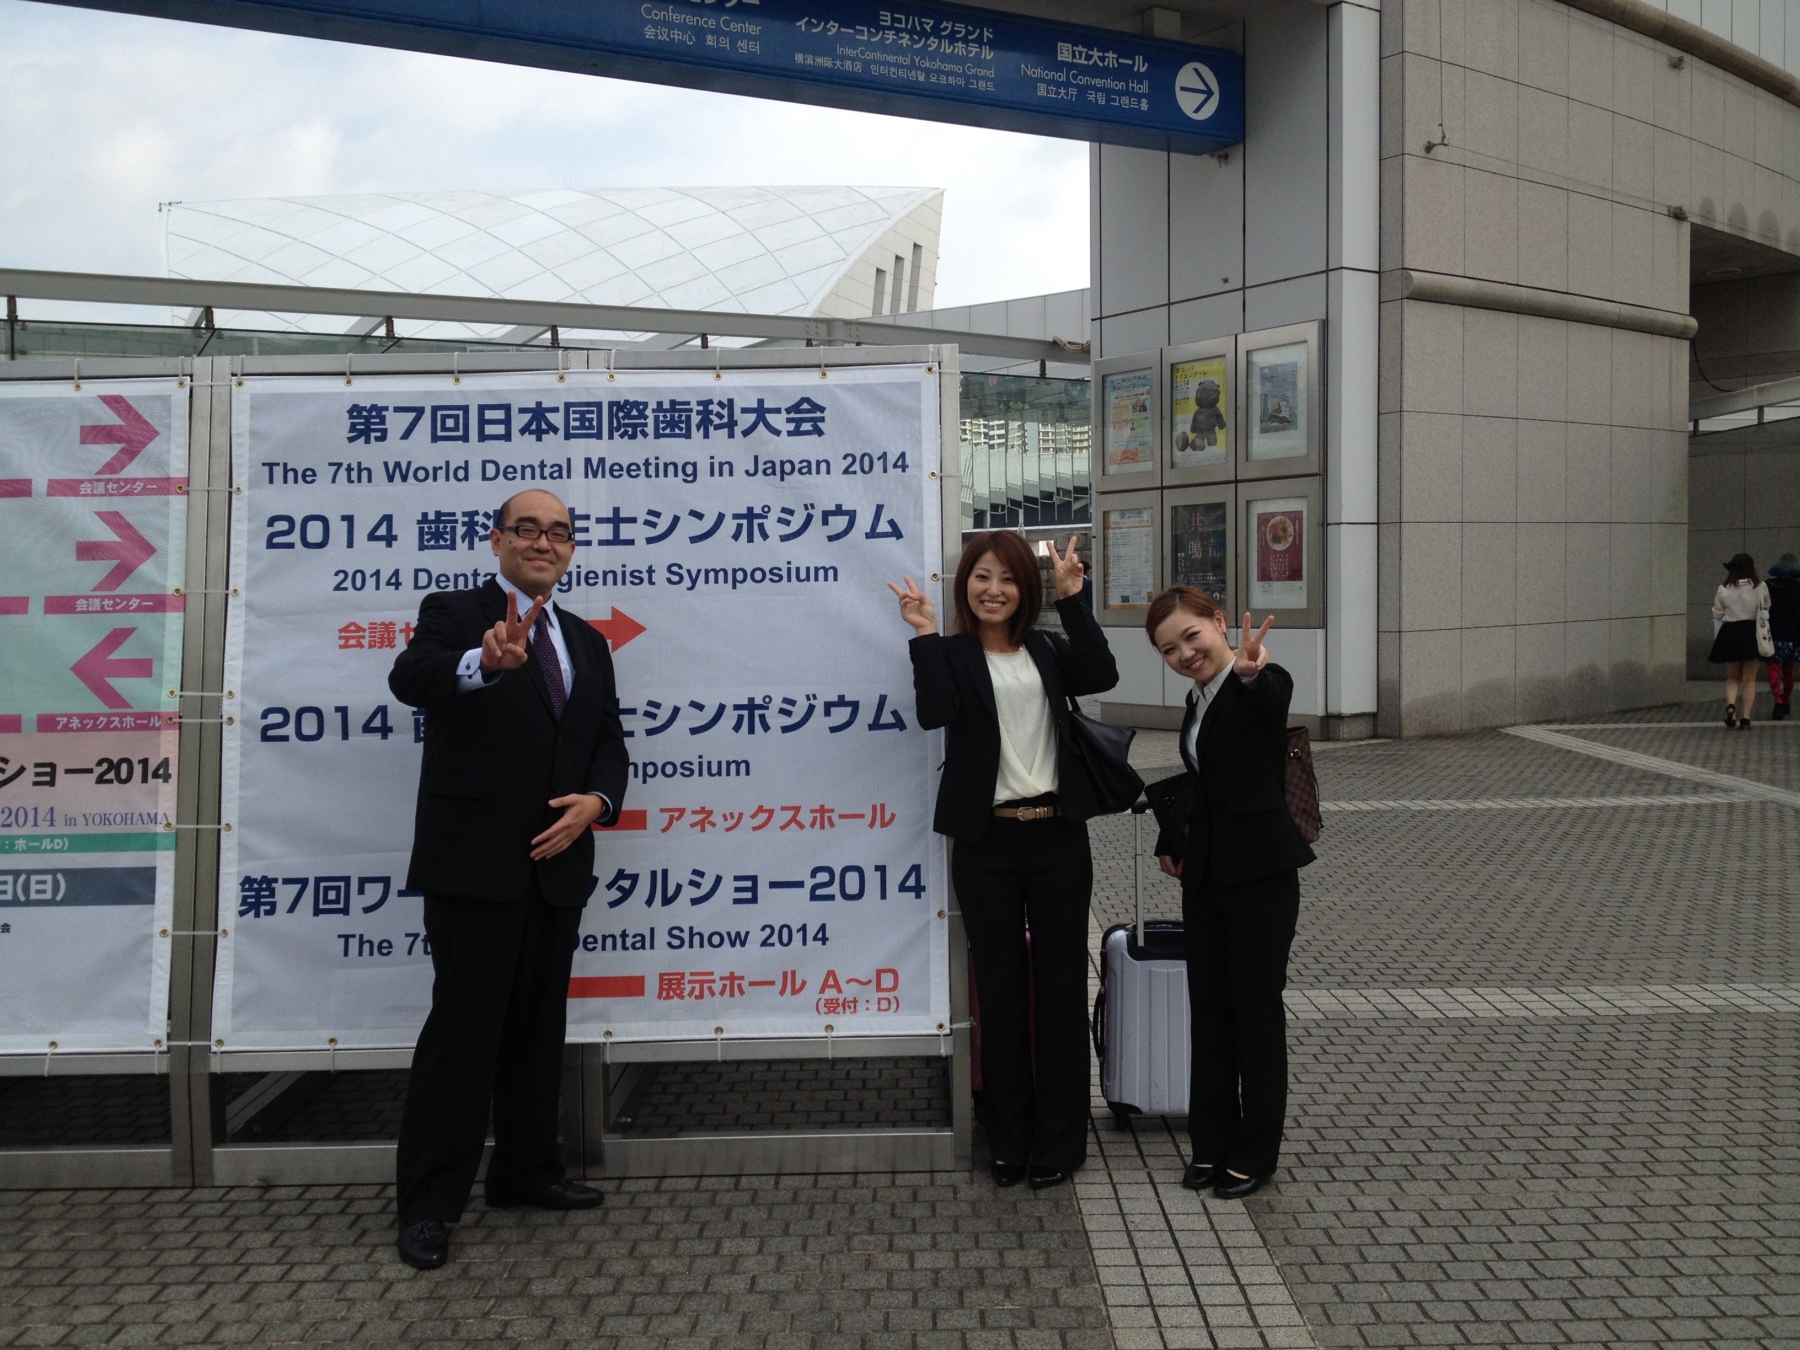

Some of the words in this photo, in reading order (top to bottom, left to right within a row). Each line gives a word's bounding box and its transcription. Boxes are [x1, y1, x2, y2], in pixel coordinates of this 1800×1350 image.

[641, 4, 716, 28] Conference
[720, 16, 761, 35] Center
[644, 24, 695, 45] 会议中心
[880, 11, 935, 32] ヨコハマ
[939, 20, 994, 43] グランド
[705, 35, 730, 50] 회의
[736, 39, 760, 55] 센터
[796, 16, 994, 60] インターコンチネンタルホテル
[794, 52, 863, 73] 横滨洲际大酒店
[837, 44, 911, 65] InterContinental
[913, 55, 962, 73] Yokohama
[965, 65, 995, 78] Grand
[1057, 42, 1148, 72] 国立大ホール
[930, 73, 965, 87] 요코하마
[969, 80, 995, 91] 그랜드
[1021, 63, 1066, 82] National
[1069, 70, 1126, 91] Convention
[1128, 79, 1149, 94] Hall
[1037, 83, 1078, 101] 国立大厅
[1086, 91, 1106, 105] 국립
[346, 397, 827, 444] 第7回日本国際歯科大会
[262, 461, 317, 484] The
[328, 461, 373, 484] 7th
[384, 460, 470, 483] World
[481, 457, 572, 482] Dental
[583, 456, 698, 484] Meeting
[709, 455, 734, 478] in
[744, 454, 831, 482] Japan
[841, 451, 909, 475] 2014
[79, 481, 157, 494] 会議センター
[265, 513, 398, 550] 2014
[333, 569, 402, 591] 2014
[413, 568, 497, 590] Denta
[557, 563, 656, 593] gienist
[666, 561, 839, 591] Symposium
[75, 599, 154, 611] 会議センター
[56, 717, 162, 729] アネックスホール
[260, 705, 393, 742] 2014
[629, 755, 750, 784] posium
[1, 806, 56, 828] 2014
[64, 814, 77, 827] in
[82, 812, 170, 826] YOKOHAMA
[659, 803, 896, 833] アネックスホール
[337, 934, 393, 957] The
[405, 933, 431, 956] 7t
[574, 927, 655, 951] ental
[667, 925, 750, 949] Show
[760, 923, 829, 948] 2014
[657, 970, 807, 1001] 展示ホール
